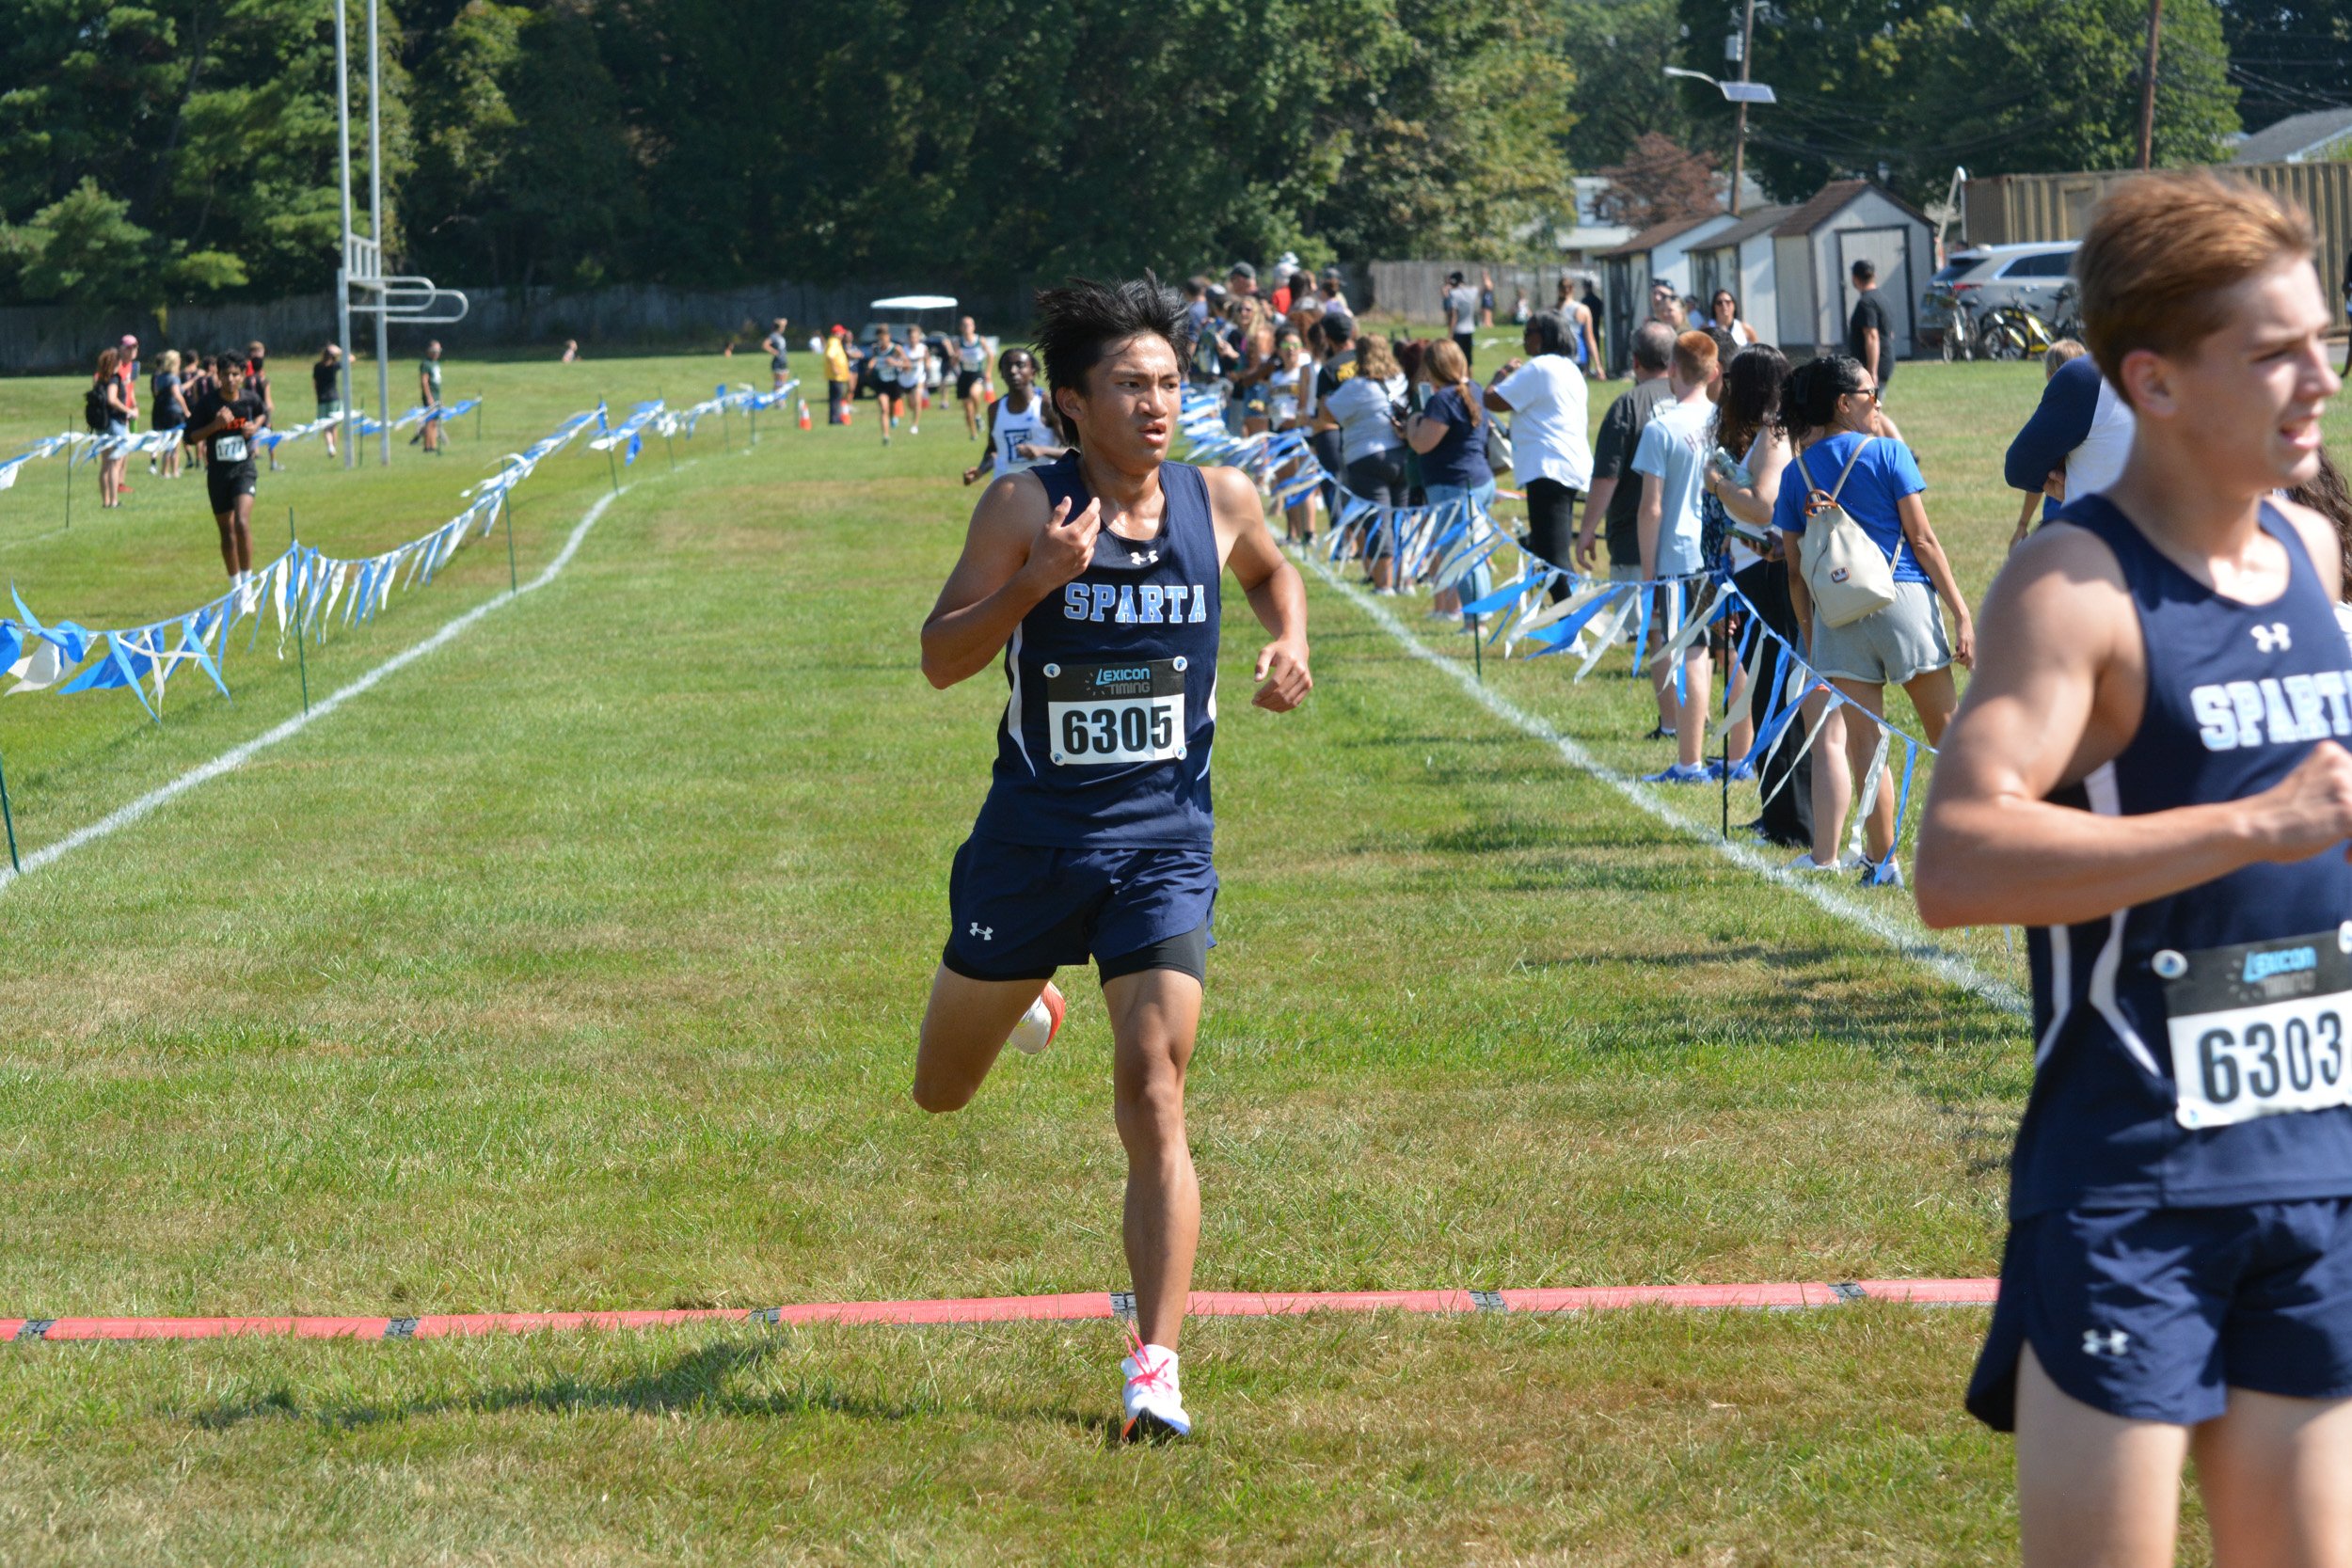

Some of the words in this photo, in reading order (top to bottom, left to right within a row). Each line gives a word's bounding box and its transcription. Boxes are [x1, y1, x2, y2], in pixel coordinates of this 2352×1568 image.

[1063, 581, 1207, 624] SPARTA
[1061, 705, 1173, 755] 6305
[2189, 670, 2352, 752] SPART
[2198, 1011, 2343, 1105] 6303
